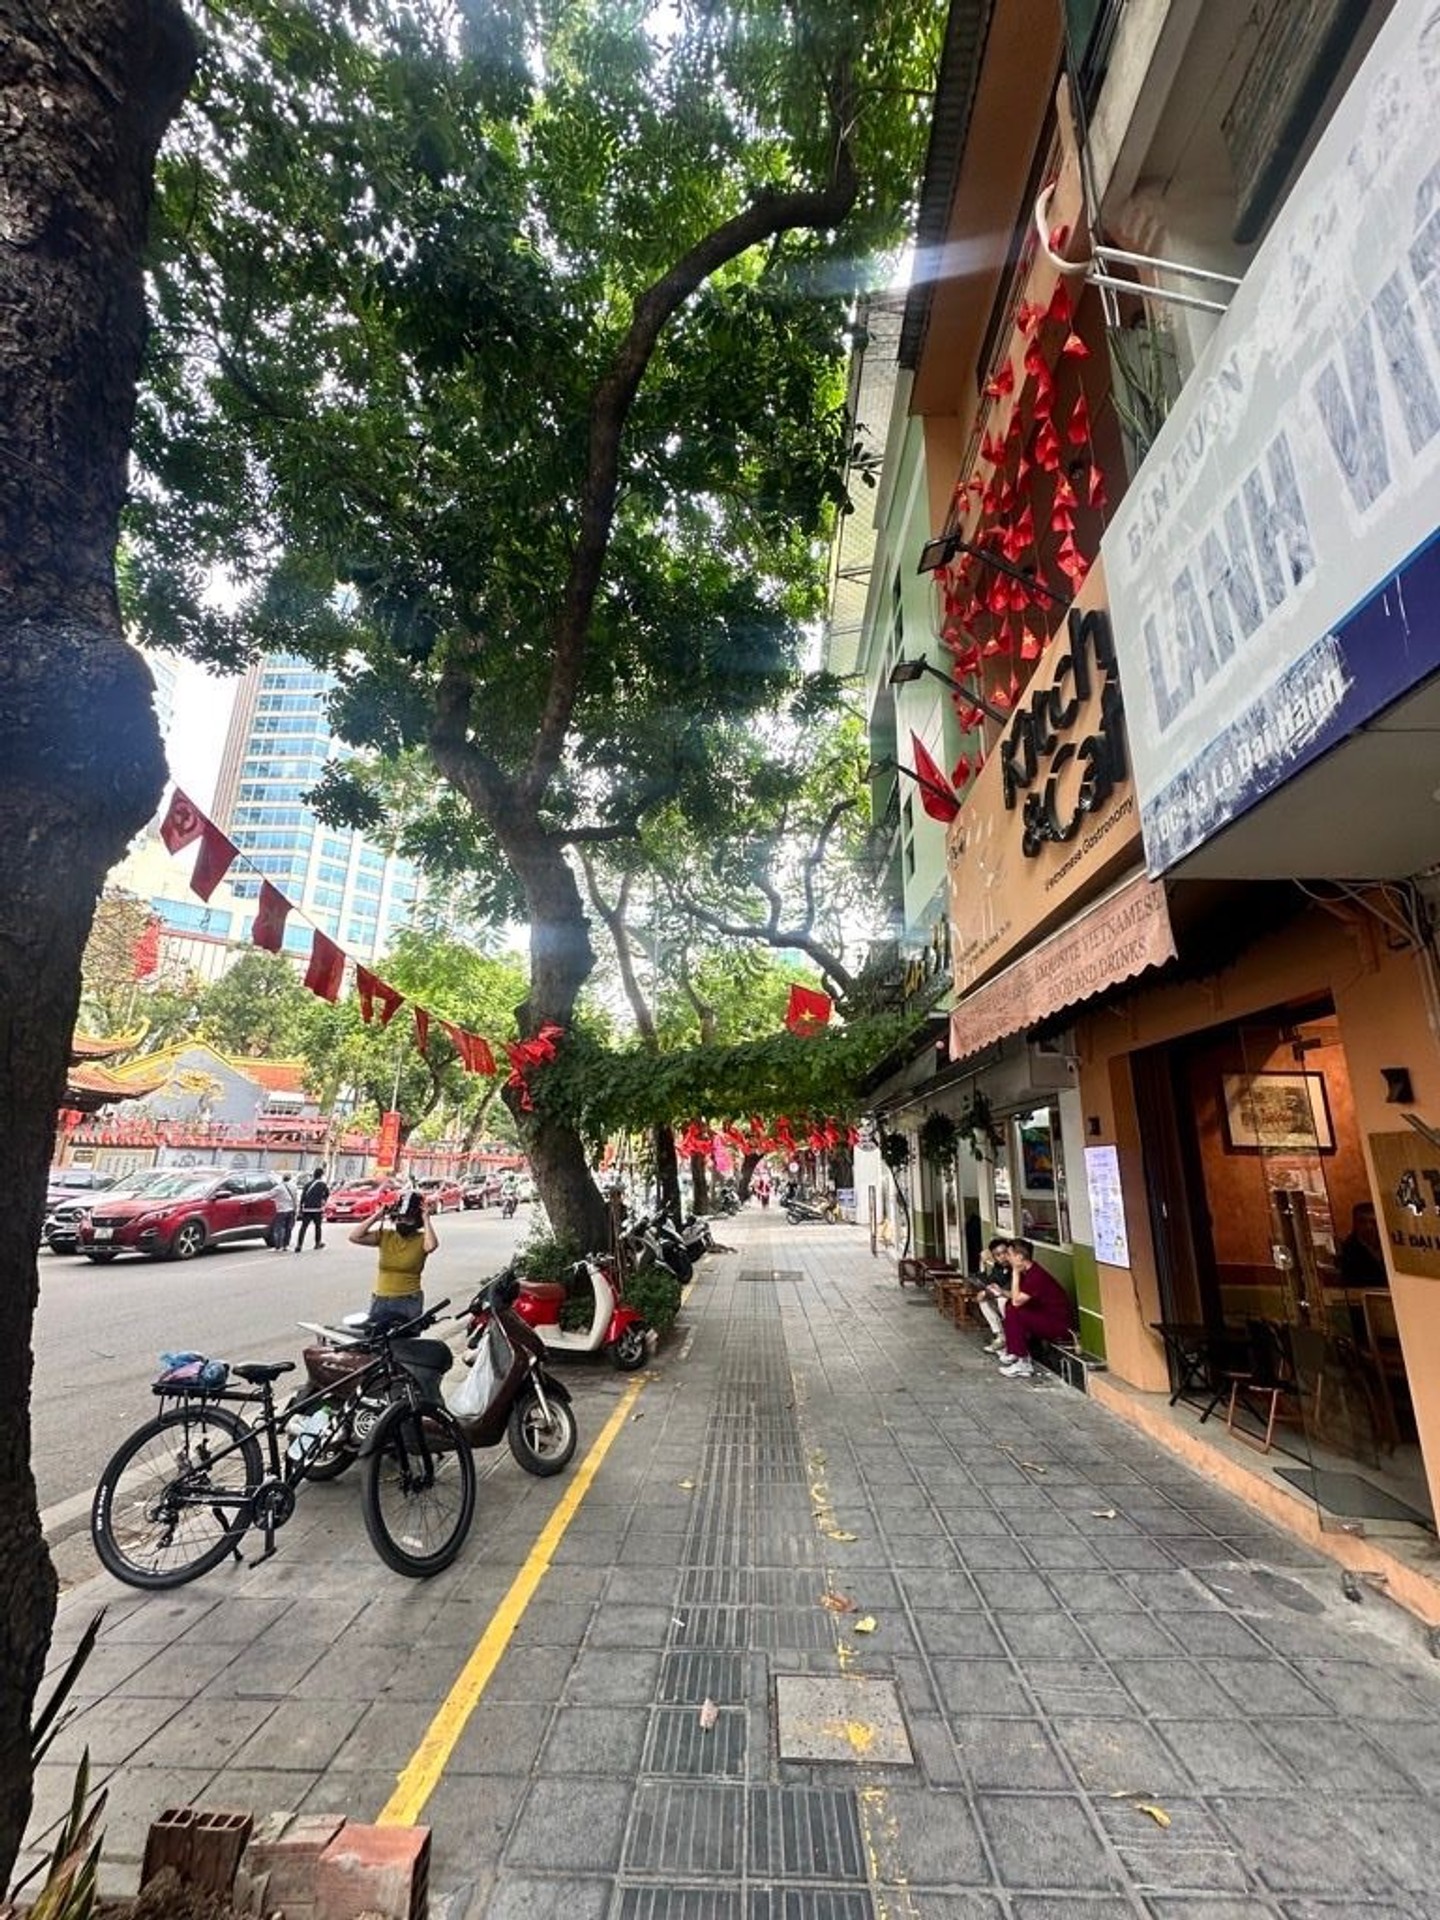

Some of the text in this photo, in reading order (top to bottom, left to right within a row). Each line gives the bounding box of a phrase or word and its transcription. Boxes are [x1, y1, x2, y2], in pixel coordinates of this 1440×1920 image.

[1082, 795, 1135, 854] Gastronomy
[1081, 889, 1165, 952] VIETNAMESE
[1098, 936, 1148, 978] DRINKS
